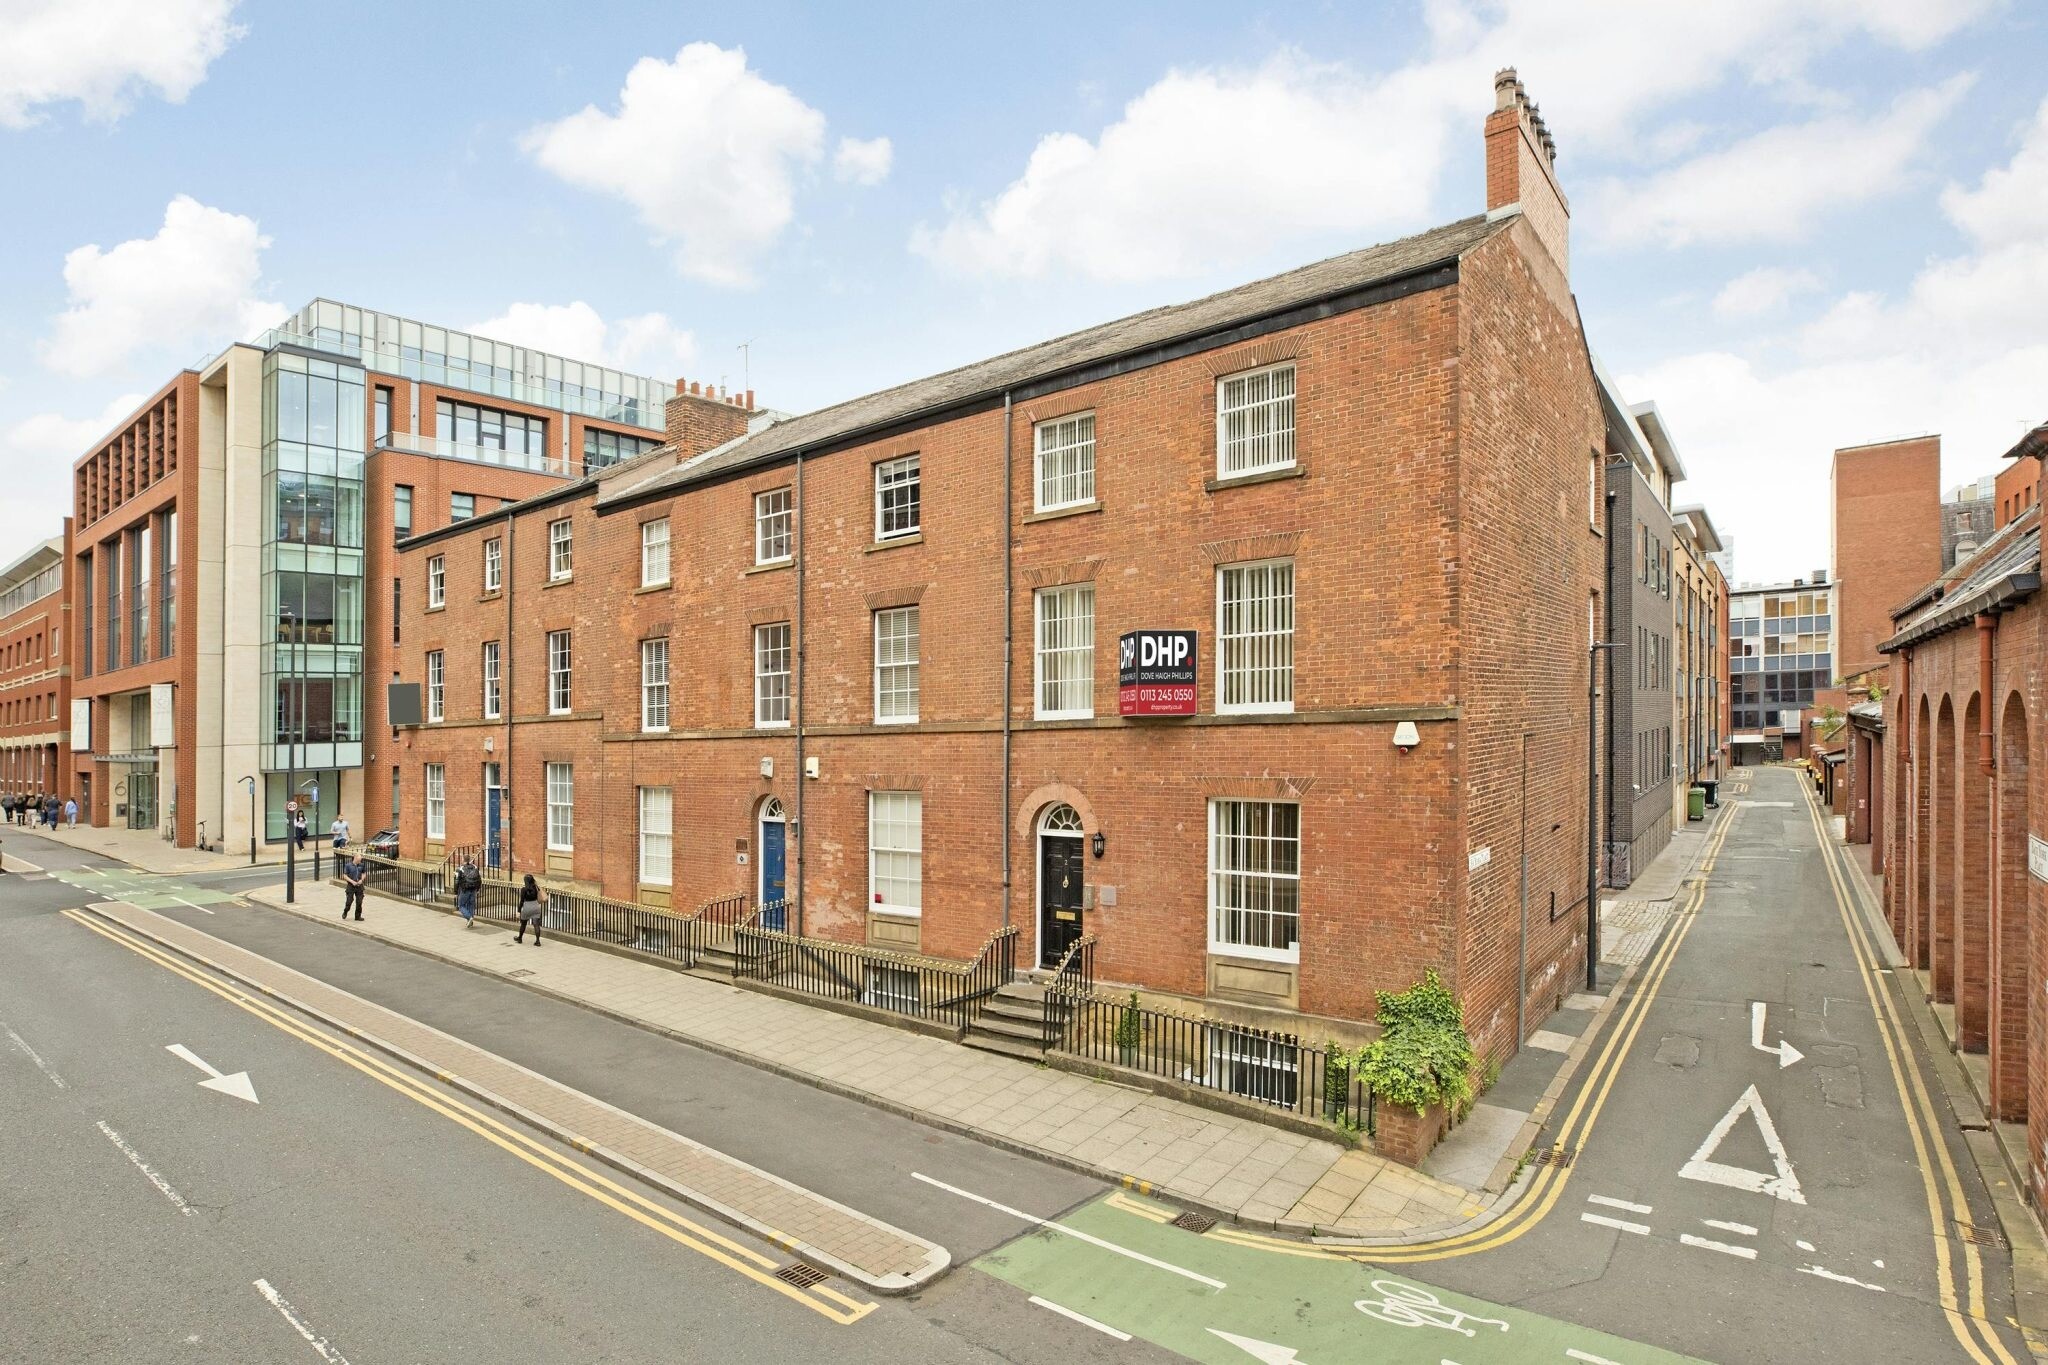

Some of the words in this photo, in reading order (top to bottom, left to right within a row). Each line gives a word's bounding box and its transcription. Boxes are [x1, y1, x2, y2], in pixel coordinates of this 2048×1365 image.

[1141, 672, 1154, 680] DOVE
[1155, 672, 1171, 680] HAIGH
[1172, 672, 1193, 680] PHILLIPS
[1140, 689, 1156, 701] 0113
[1158, 689, 1172, 701] 245
[1174, 688, 1193, 701] 0550
[114, 781, 127, 797] 6
